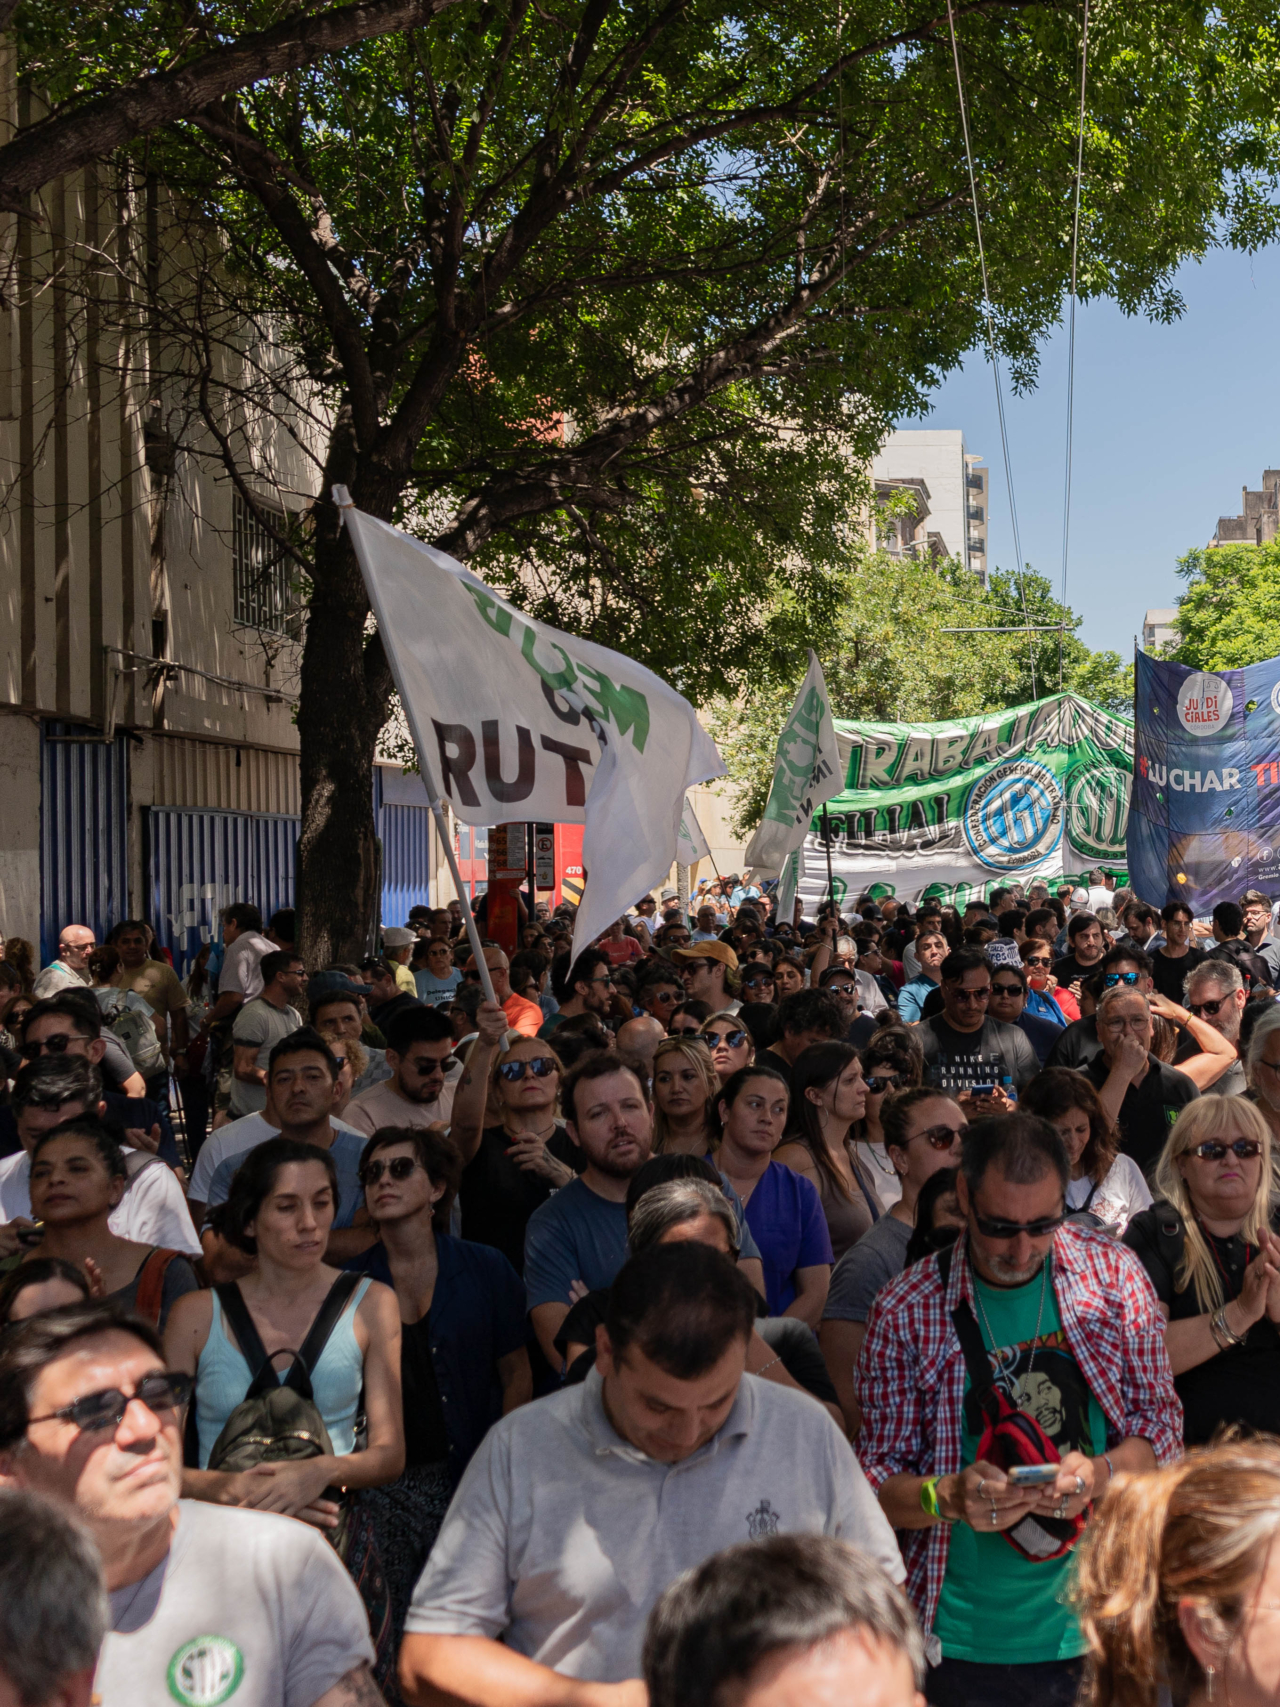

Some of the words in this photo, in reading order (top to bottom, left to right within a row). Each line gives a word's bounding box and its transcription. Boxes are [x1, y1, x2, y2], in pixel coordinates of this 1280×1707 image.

[836, 696, 1135, 790] TRABAJADO
[430, 717, 594, 808] RUT
[1140, 756, 1243, 794] #LUCHAR
[816, 793, 957, 855] FILIAL
[565, 866, 582, 875] 470
[941, 1066, 999, 1075] RUNNING
[954, 1054, 983, 1063] NIKE
